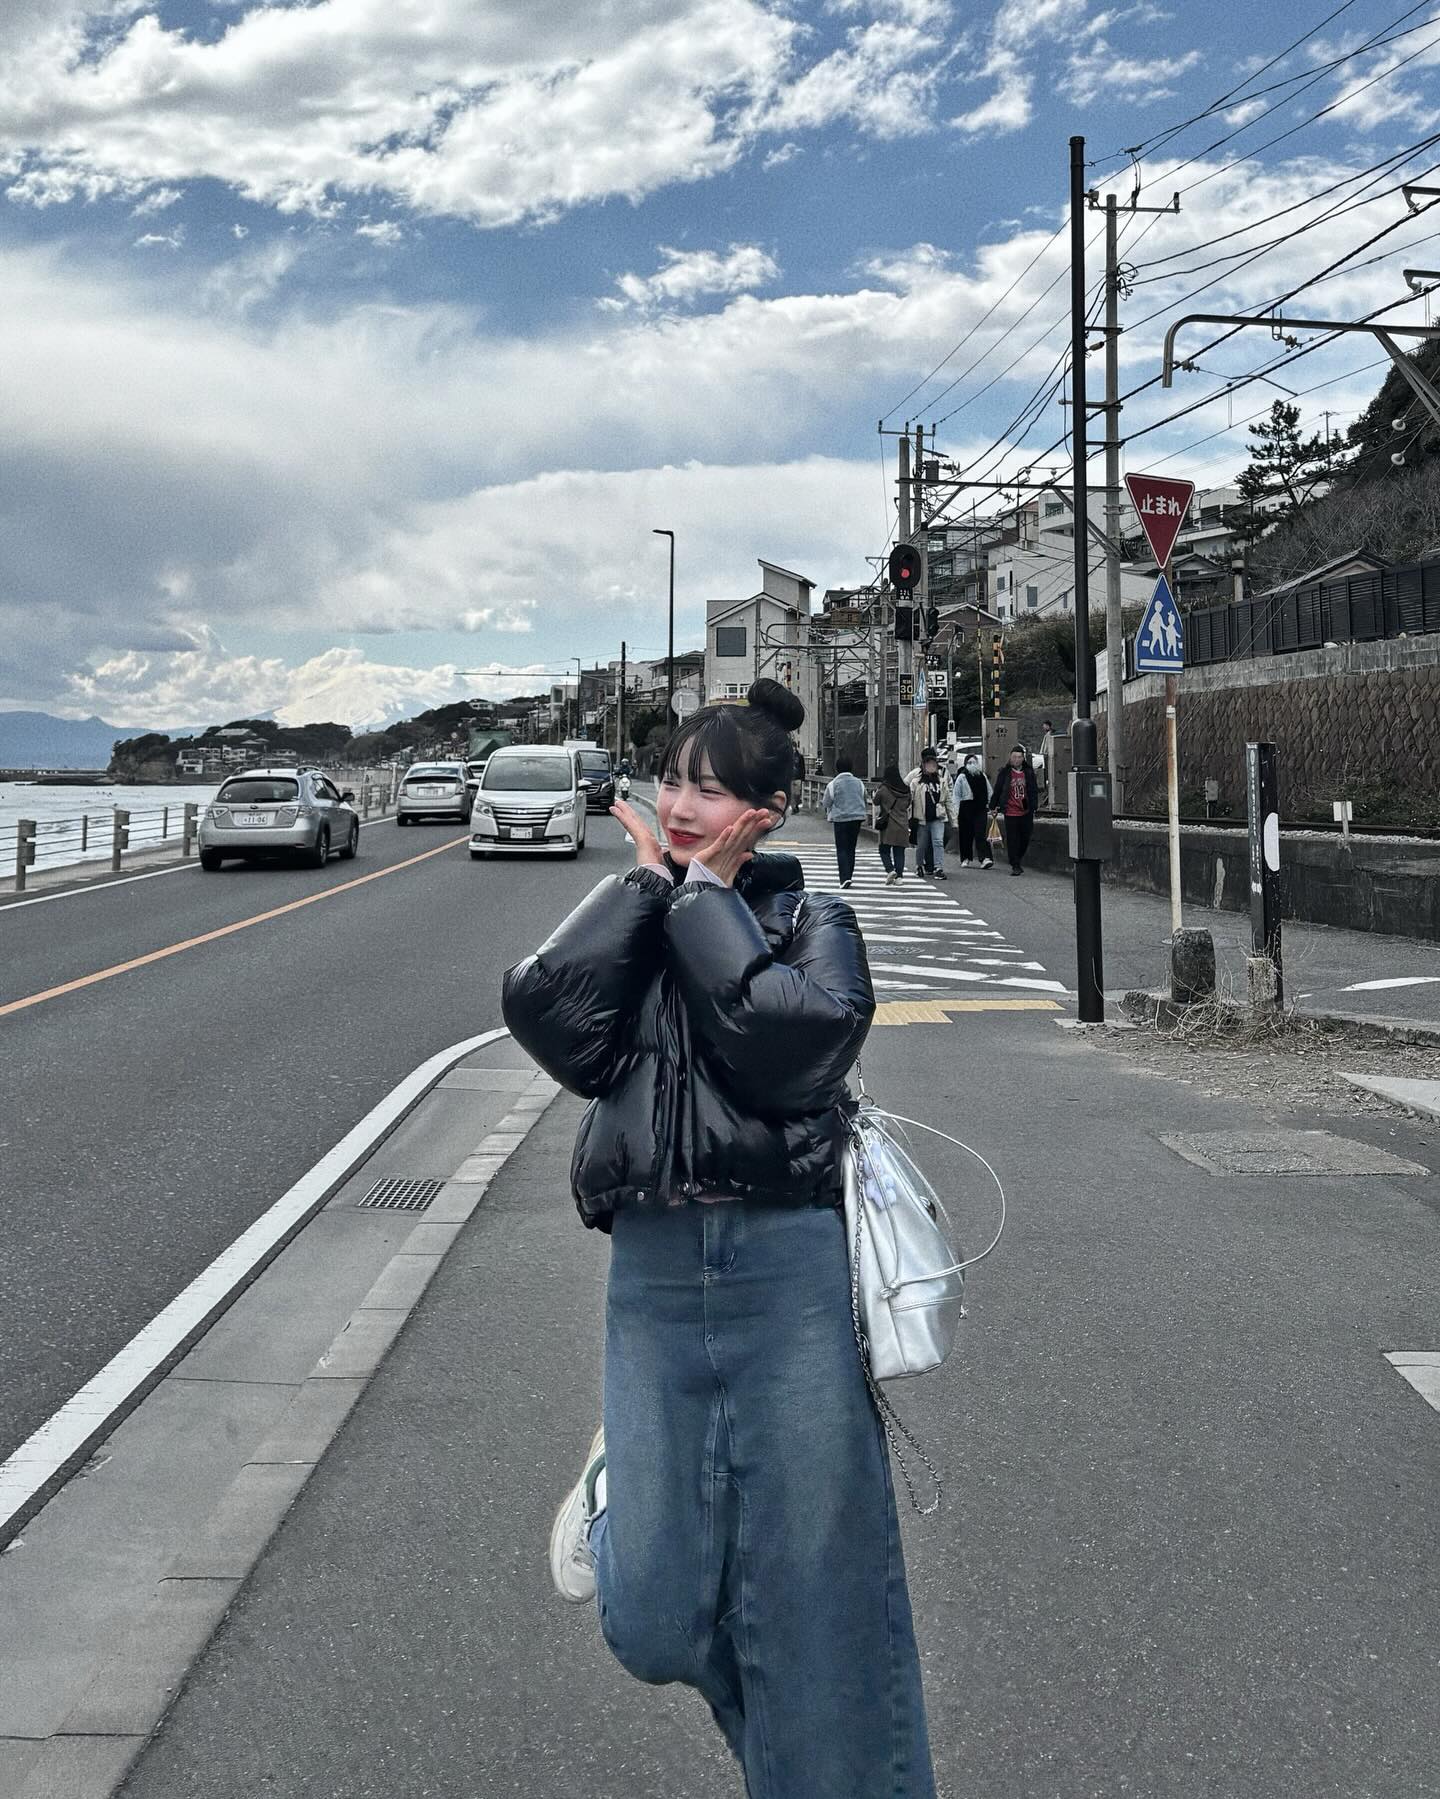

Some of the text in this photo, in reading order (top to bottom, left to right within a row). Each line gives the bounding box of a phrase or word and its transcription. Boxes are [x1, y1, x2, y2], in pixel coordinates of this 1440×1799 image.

[1140, 493, 1182, 517] 止まれ
[935, 674, 945, 686] P
[900, 684, 913, 694] 30
